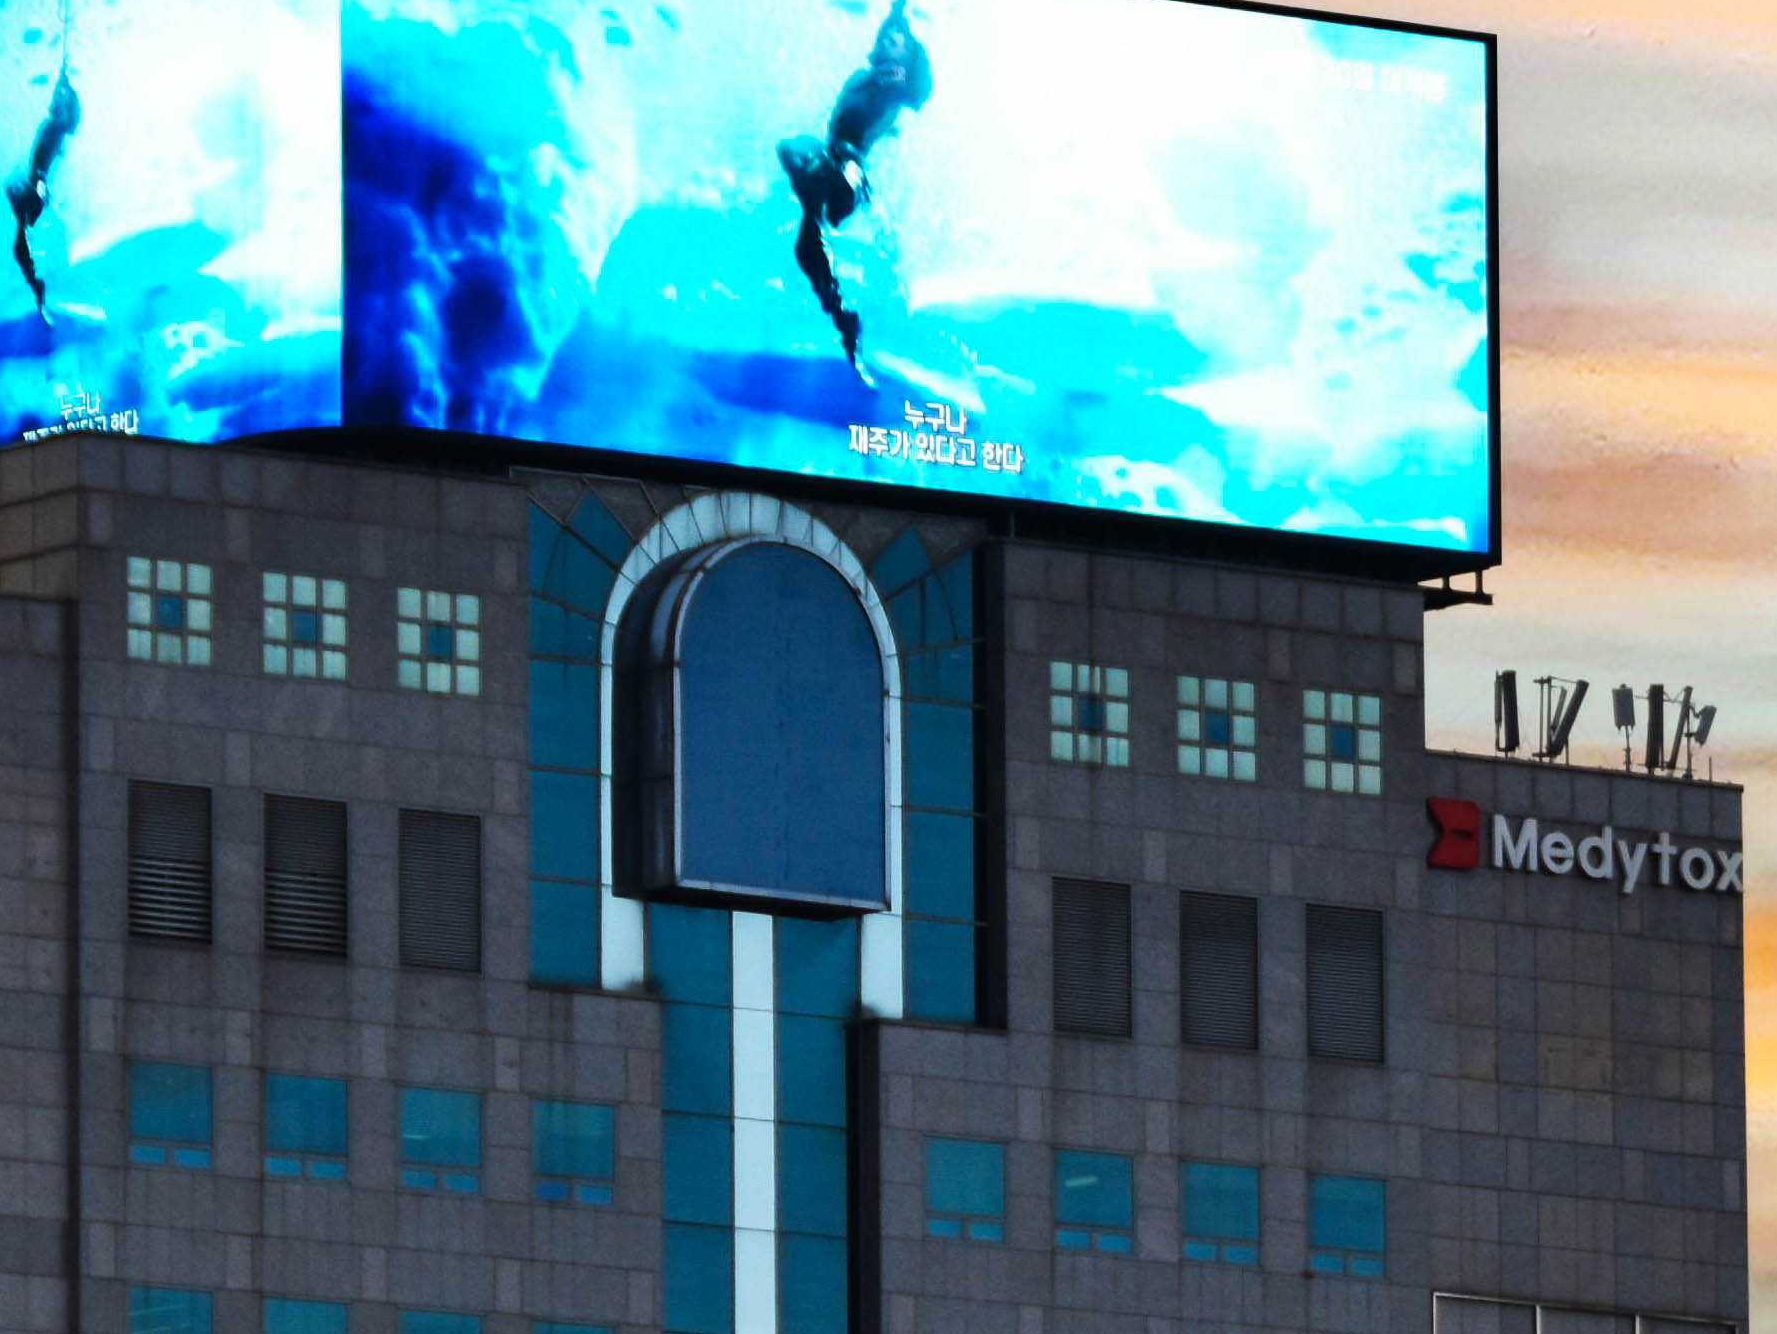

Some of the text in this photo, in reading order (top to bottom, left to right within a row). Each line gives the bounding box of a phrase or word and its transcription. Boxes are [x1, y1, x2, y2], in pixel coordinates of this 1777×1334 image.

[904, 400, 967, 435] 누구나
[848, 424, 1024, 474] 재주가 있다고 한다
[1493, 814, 1744, 894] Medytox
